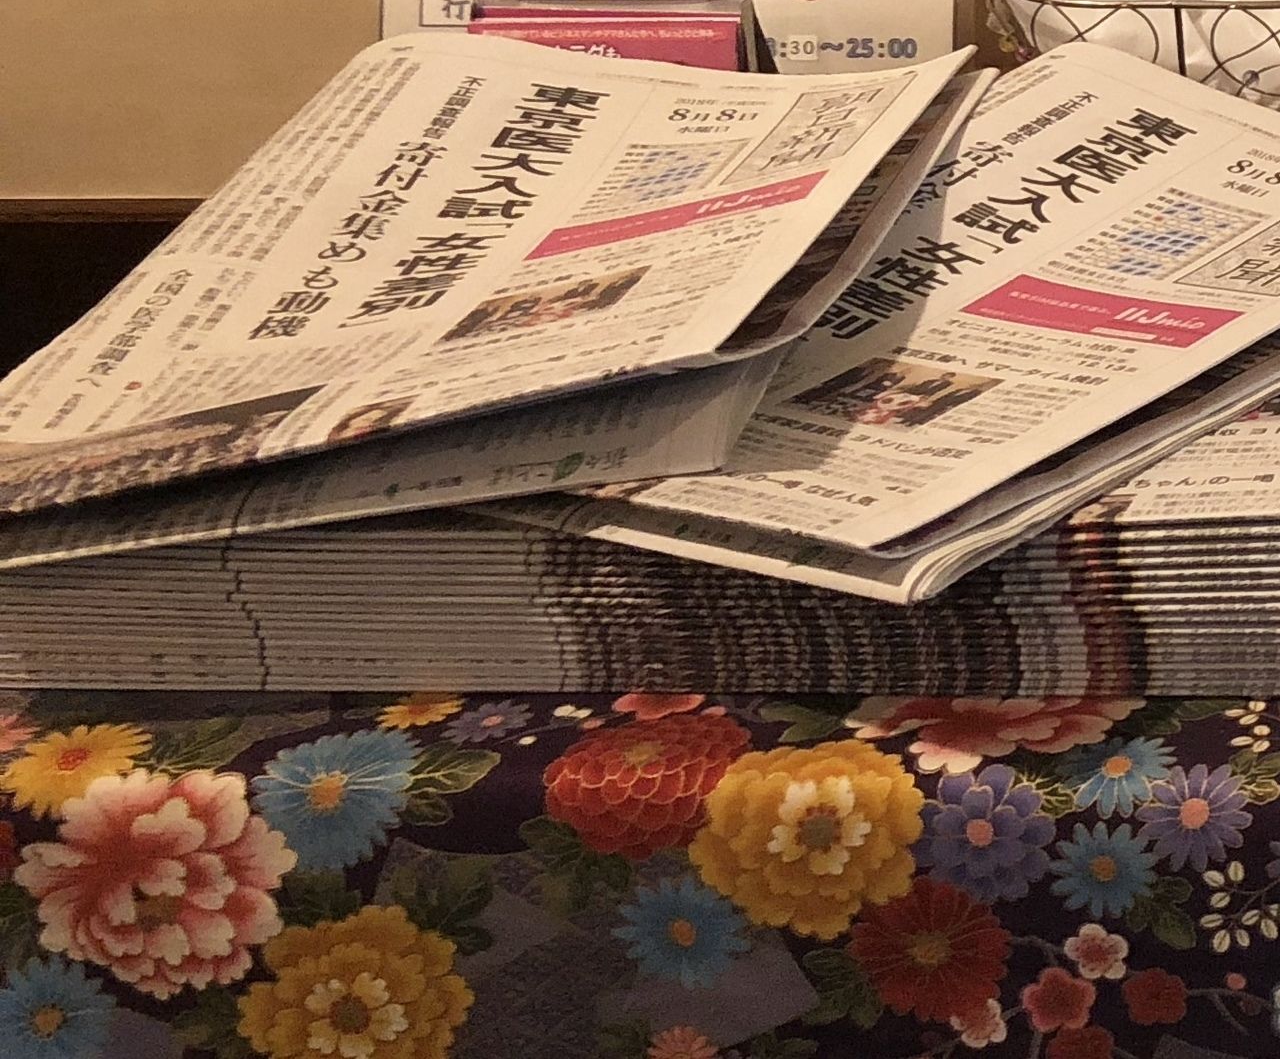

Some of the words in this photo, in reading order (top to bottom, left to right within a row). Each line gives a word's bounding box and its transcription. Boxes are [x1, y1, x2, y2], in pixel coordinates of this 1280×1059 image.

[668, 107, 758, 123] 8月8日
[248, 140, 449, 340] 寄付金集めも動機
